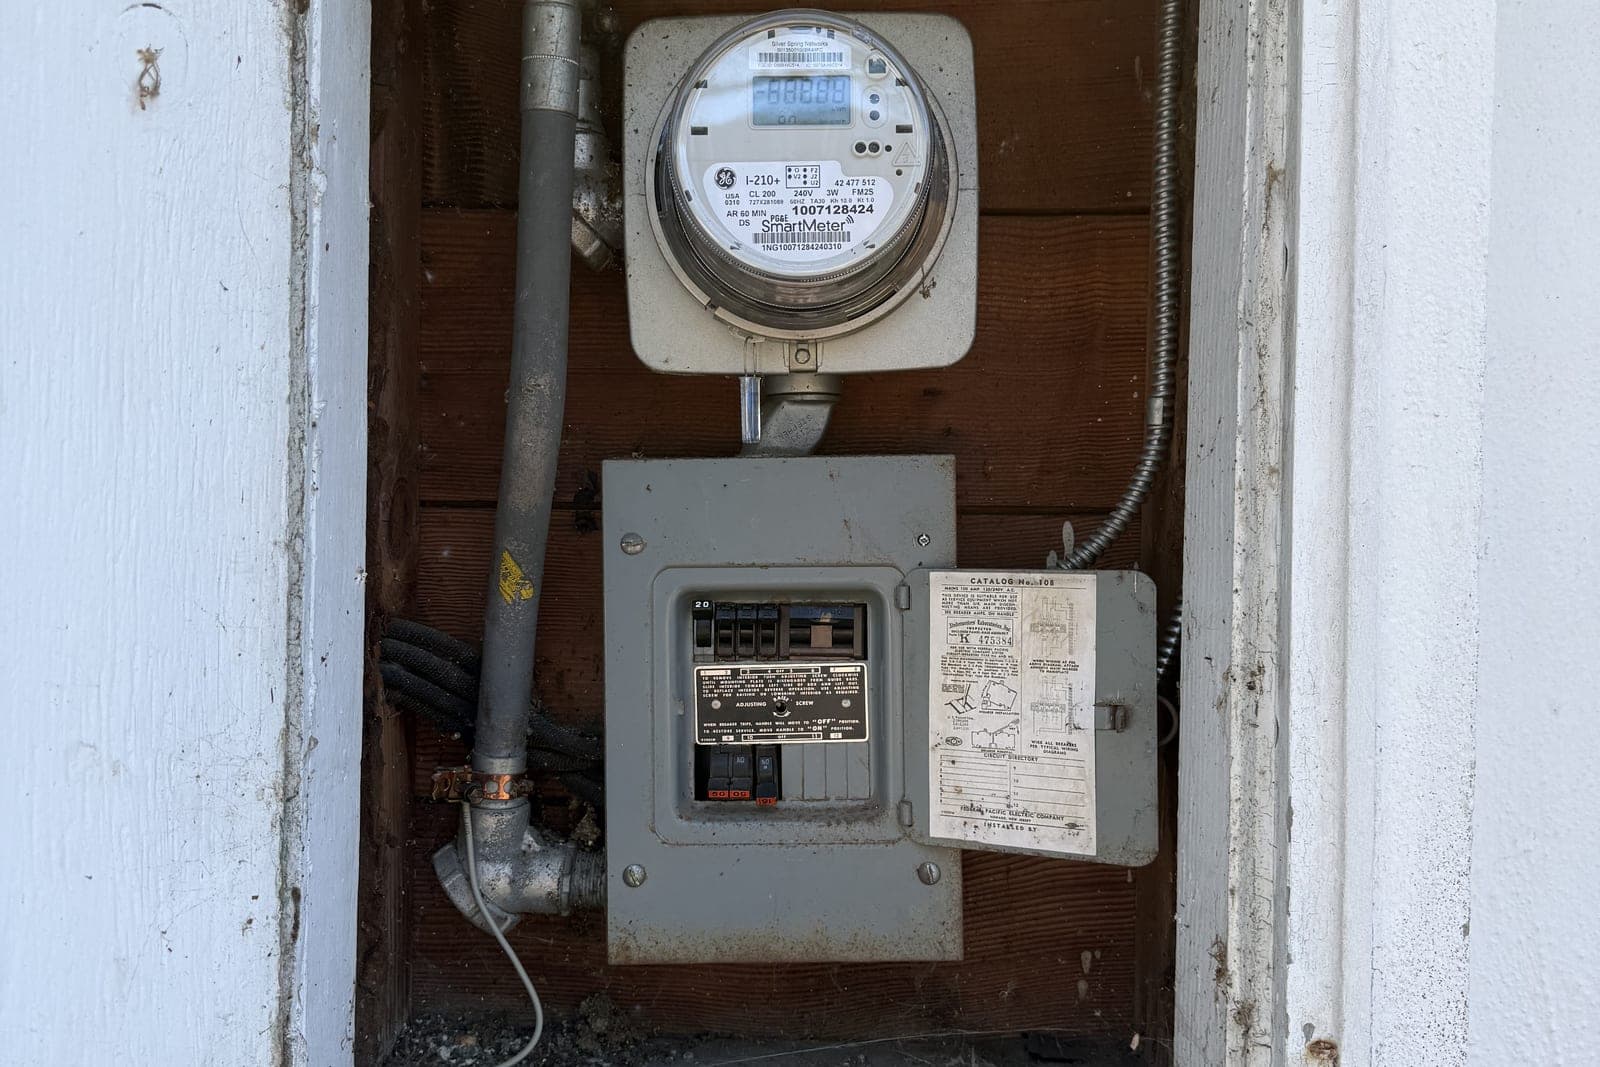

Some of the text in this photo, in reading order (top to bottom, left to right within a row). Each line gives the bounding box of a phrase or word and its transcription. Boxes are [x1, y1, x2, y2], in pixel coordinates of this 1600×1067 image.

[746, 174, 780, 186] I-210+
[792, 204, 874, 215] 1007128424
[762, 219, 846, 233] SmartMeter
[960, 634, 1011, 645] K 475384
[1008, 754, 1038, 762] DIRECTORY
